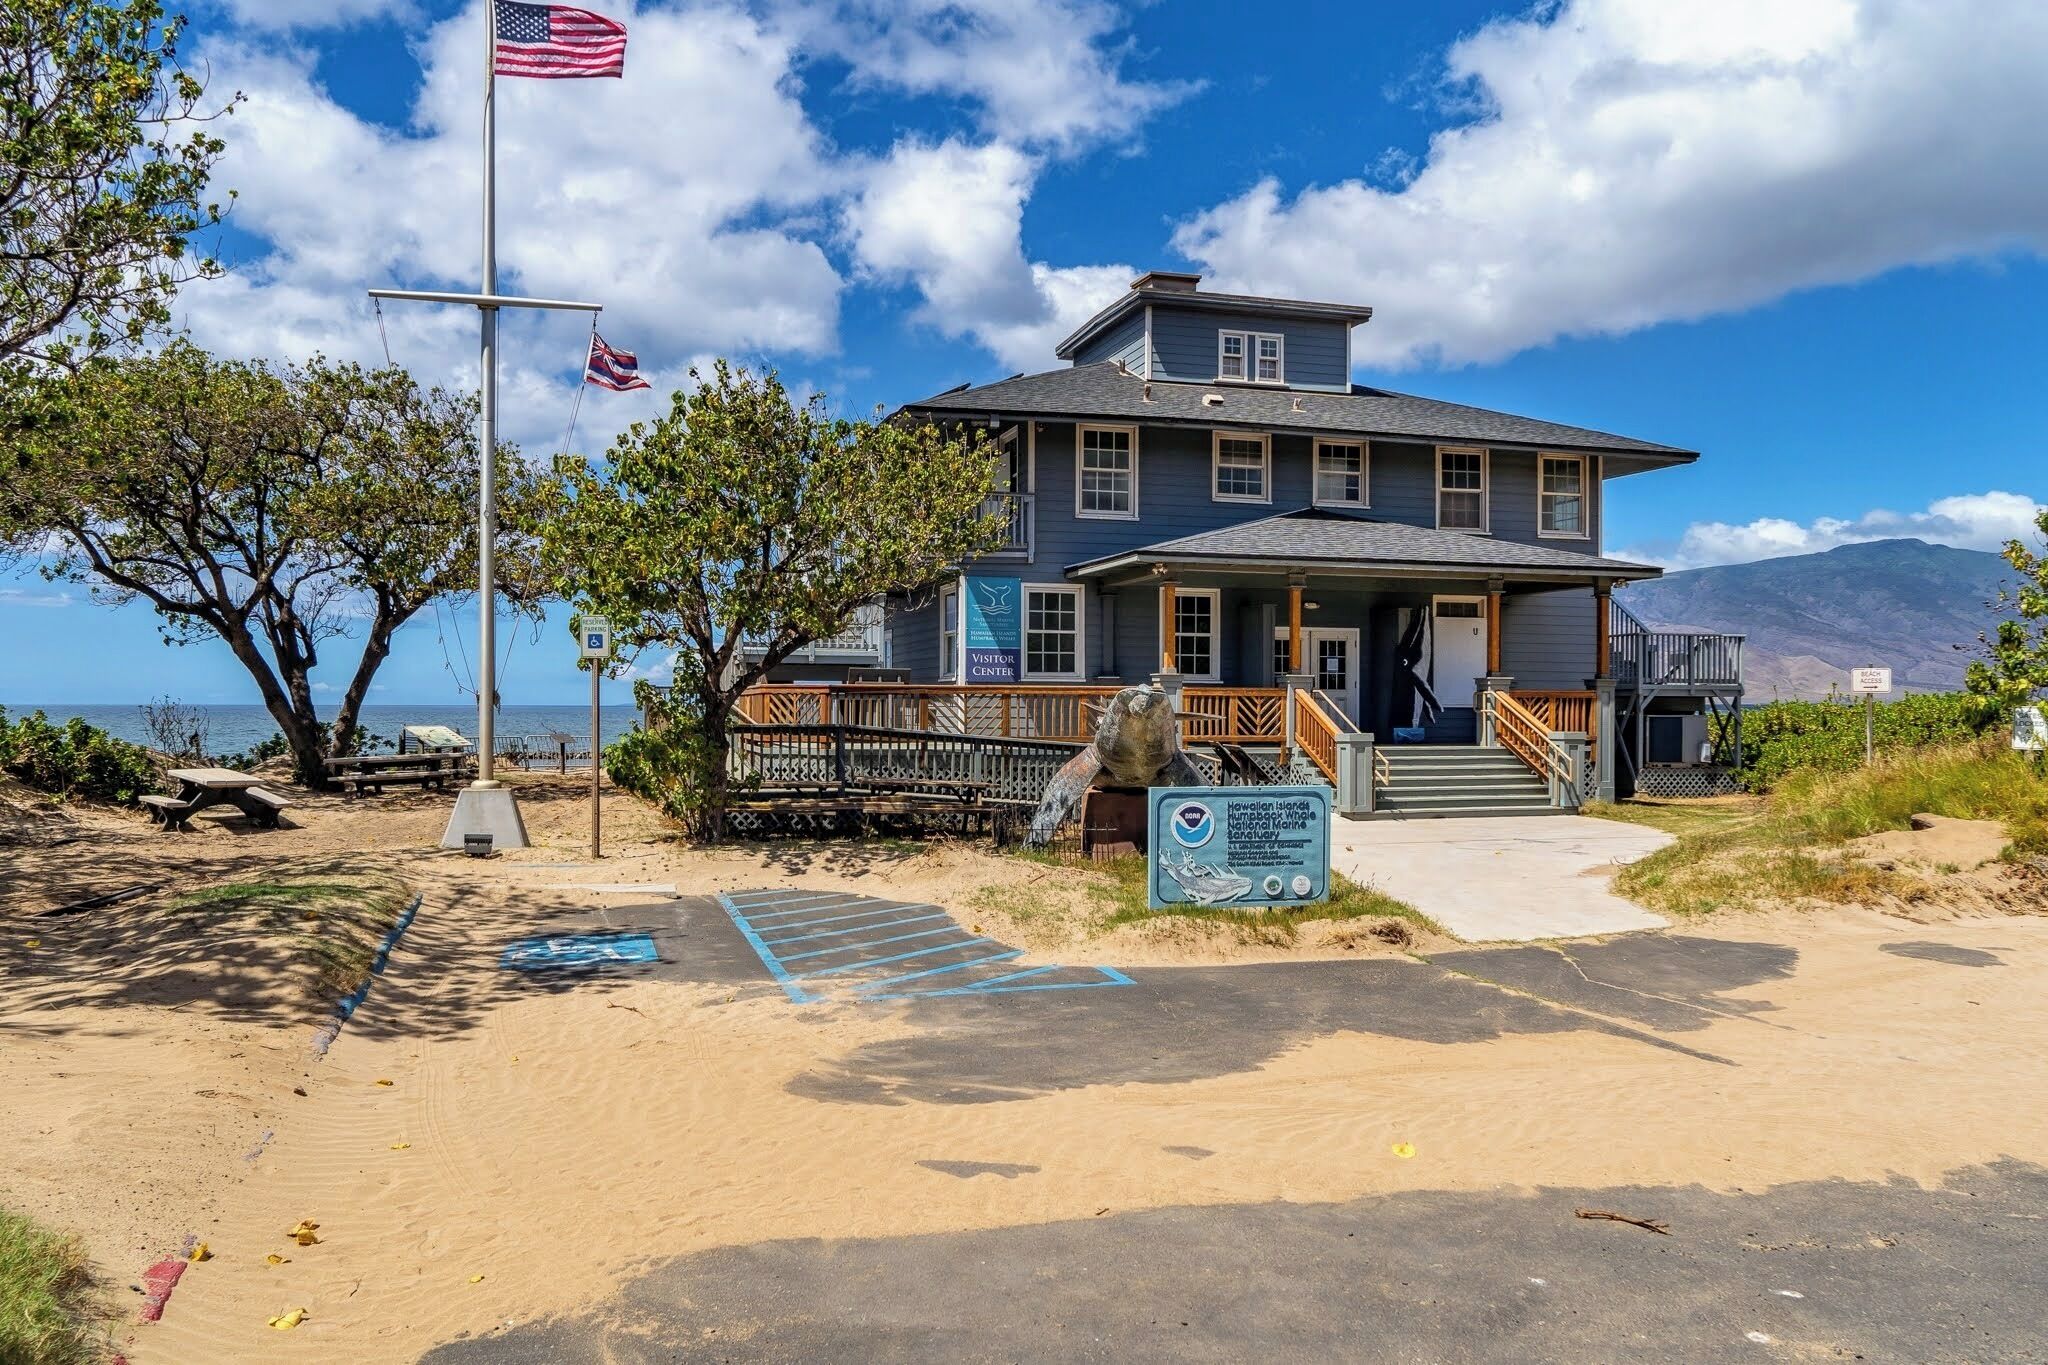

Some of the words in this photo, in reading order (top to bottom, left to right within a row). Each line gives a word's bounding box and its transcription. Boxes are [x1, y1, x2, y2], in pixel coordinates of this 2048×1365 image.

[972, 653, 1015, 664] VISITOR
[972, 665, 1015, 676] CENTER
[1228, 801, 1274, 811] Hawaiian
[1276, 800, 1310, 810] Islands
[1228, 811, 1283, 821] Humpback
[1285, 810, 1316, 820] Whale
[1228, 820, 1270, 830] National
[1272, 819, 1307, 829] Marine
[1227, 830, 1280, 841] Sanctuary
